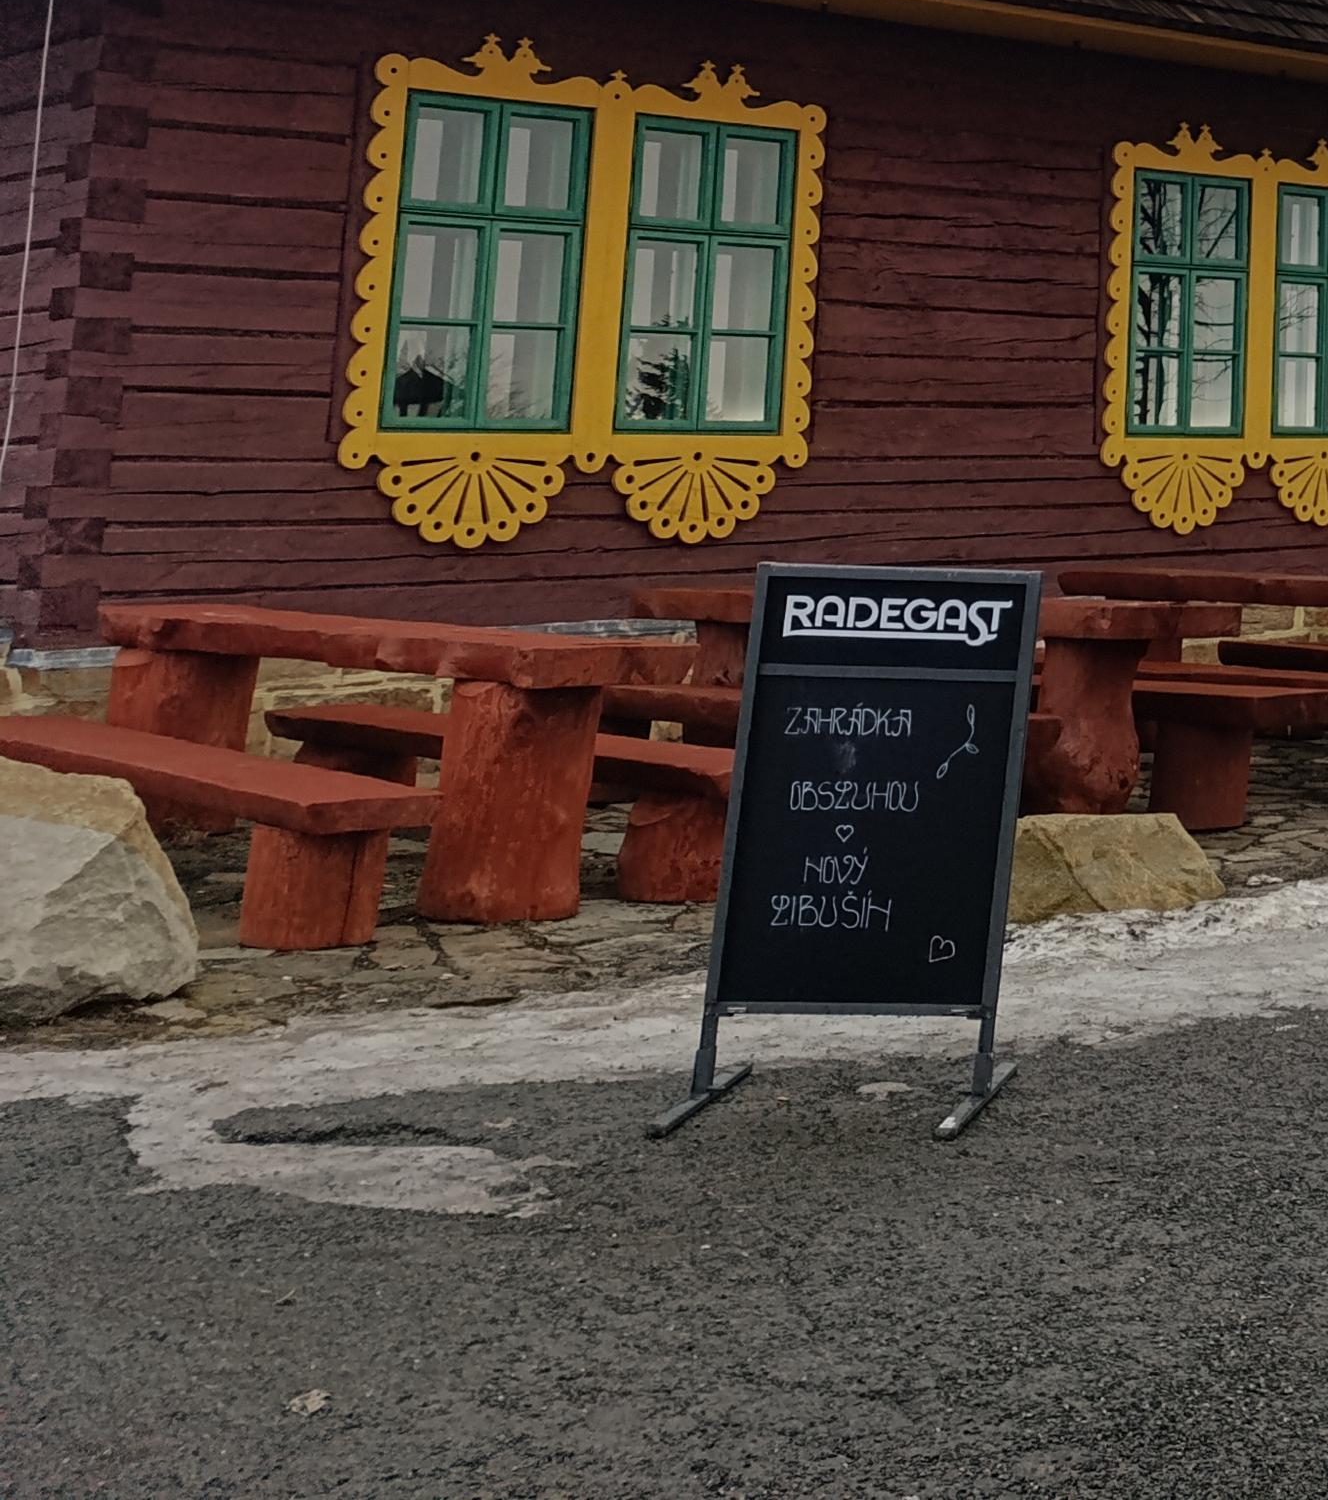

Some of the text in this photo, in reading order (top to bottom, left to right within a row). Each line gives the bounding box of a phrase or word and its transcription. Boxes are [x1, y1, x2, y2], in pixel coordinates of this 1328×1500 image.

[782, 594, 1013, 647] RADEGAST
[784, 702, 912, 737] ZAHRÁDKA
[789, 780, 919, 812] OBSLUHOU
[803, 847, 869, 885] NOVÝ
[770, 890, 892, 931] LIBUŠÍN
